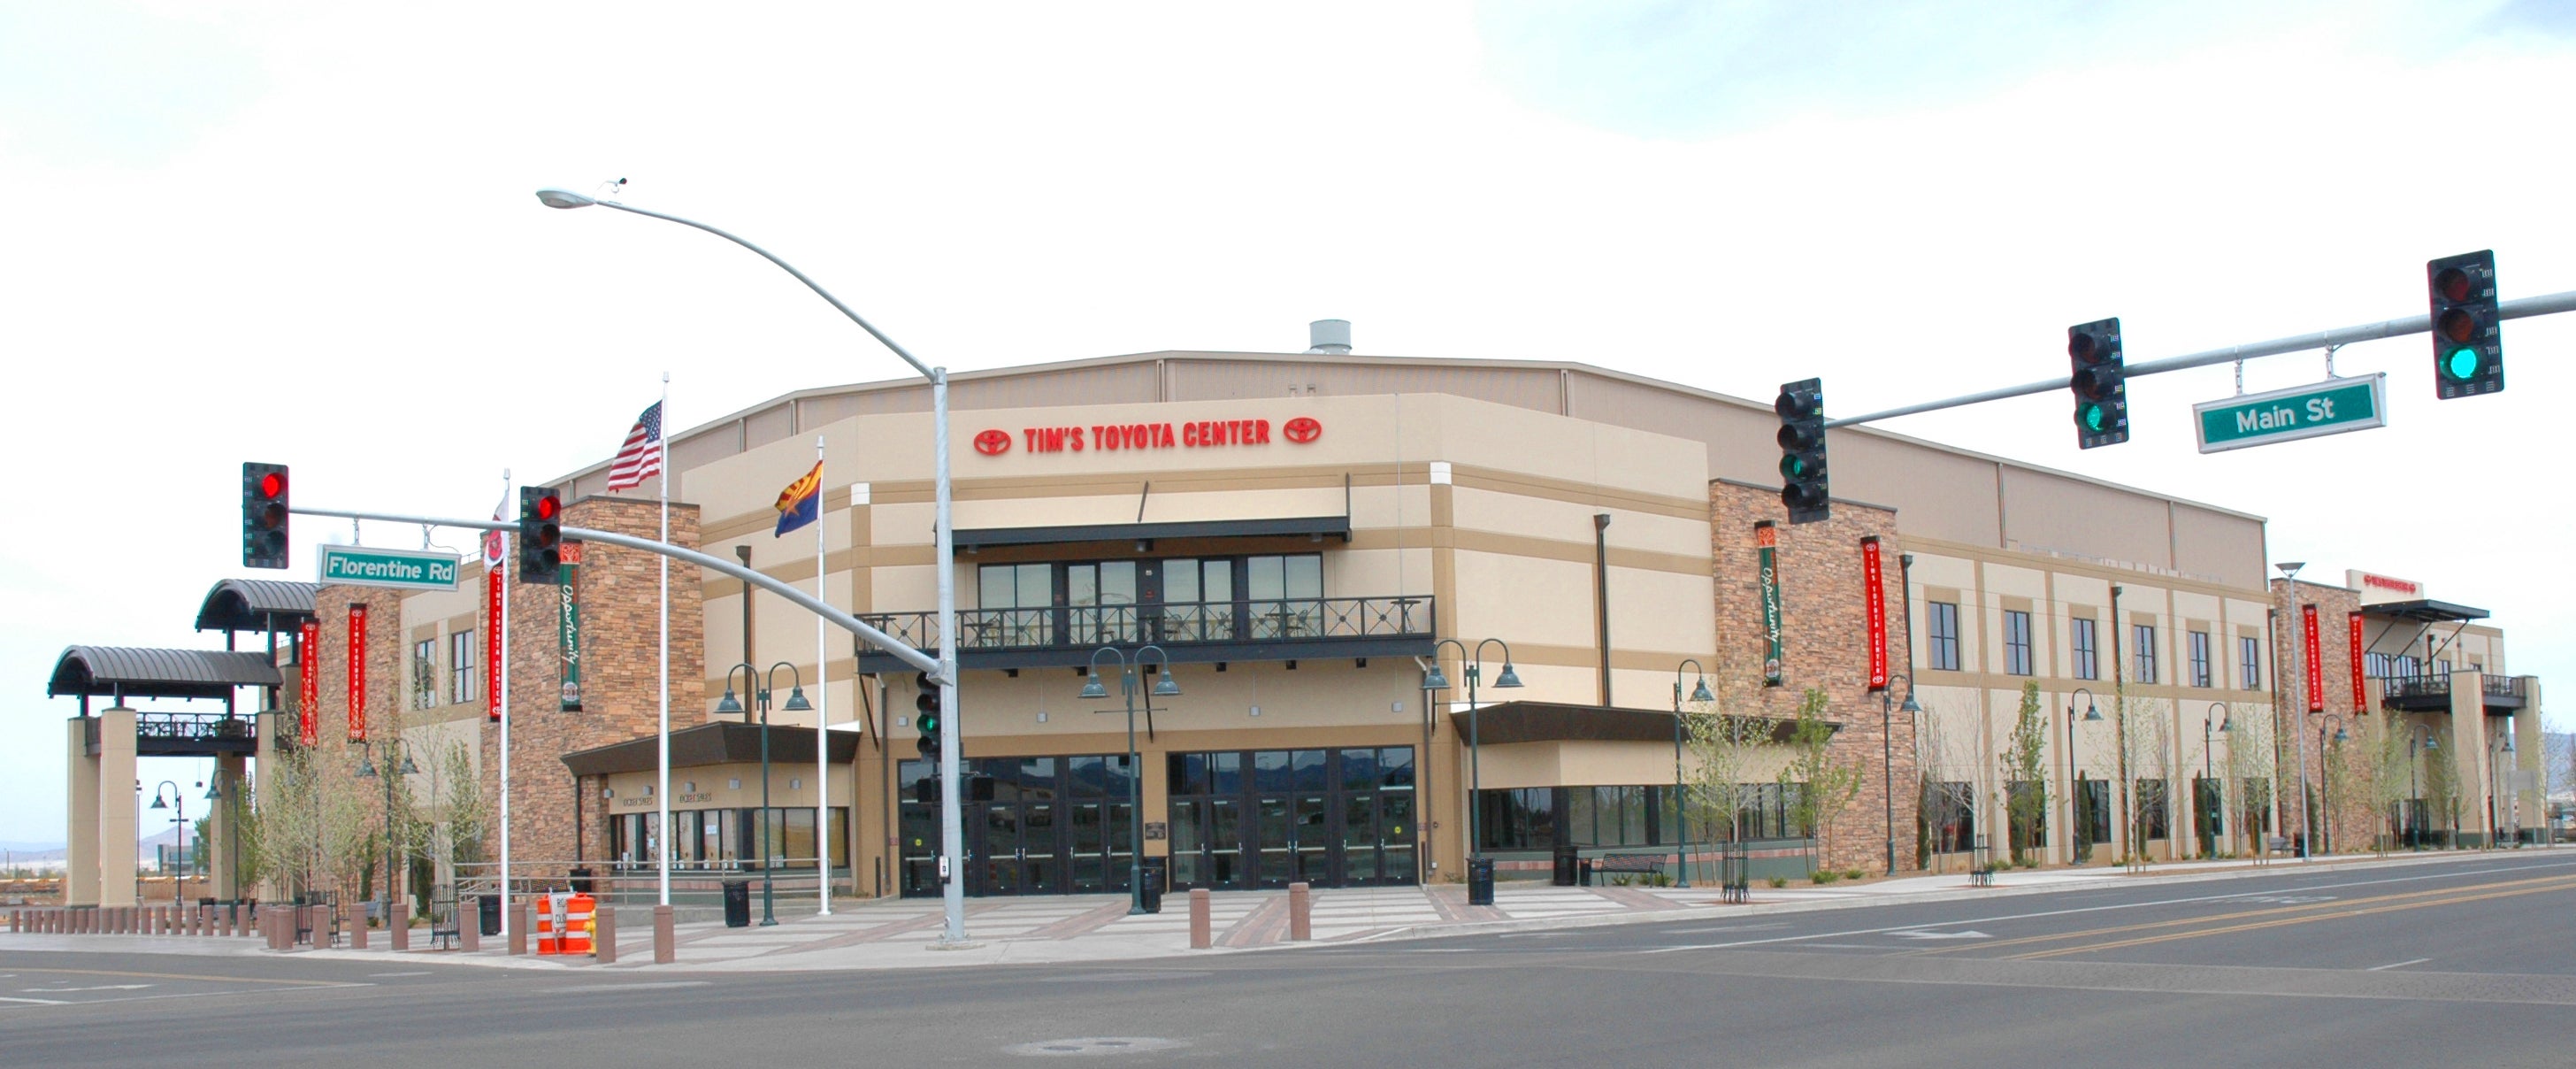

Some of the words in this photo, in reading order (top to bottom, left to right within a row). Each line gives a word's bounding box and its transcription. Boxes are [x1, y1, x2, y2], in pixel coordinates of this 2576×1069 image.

[2235, 405, 2296, 433] Main
[2305, 396, 2335, 422] St
[1024, 427, 1085, 453] TIM'S
[1092, 423, 1176, 450] TOYOTA
[1183, 419, 1271, 447] CENTER
[328, 556, 423, 579] Florentine
[428, 563, 454, 581] Rd
[1760, 567, 1781, 642] Opportunity
[560, 584, 579, 665] Opportunity
